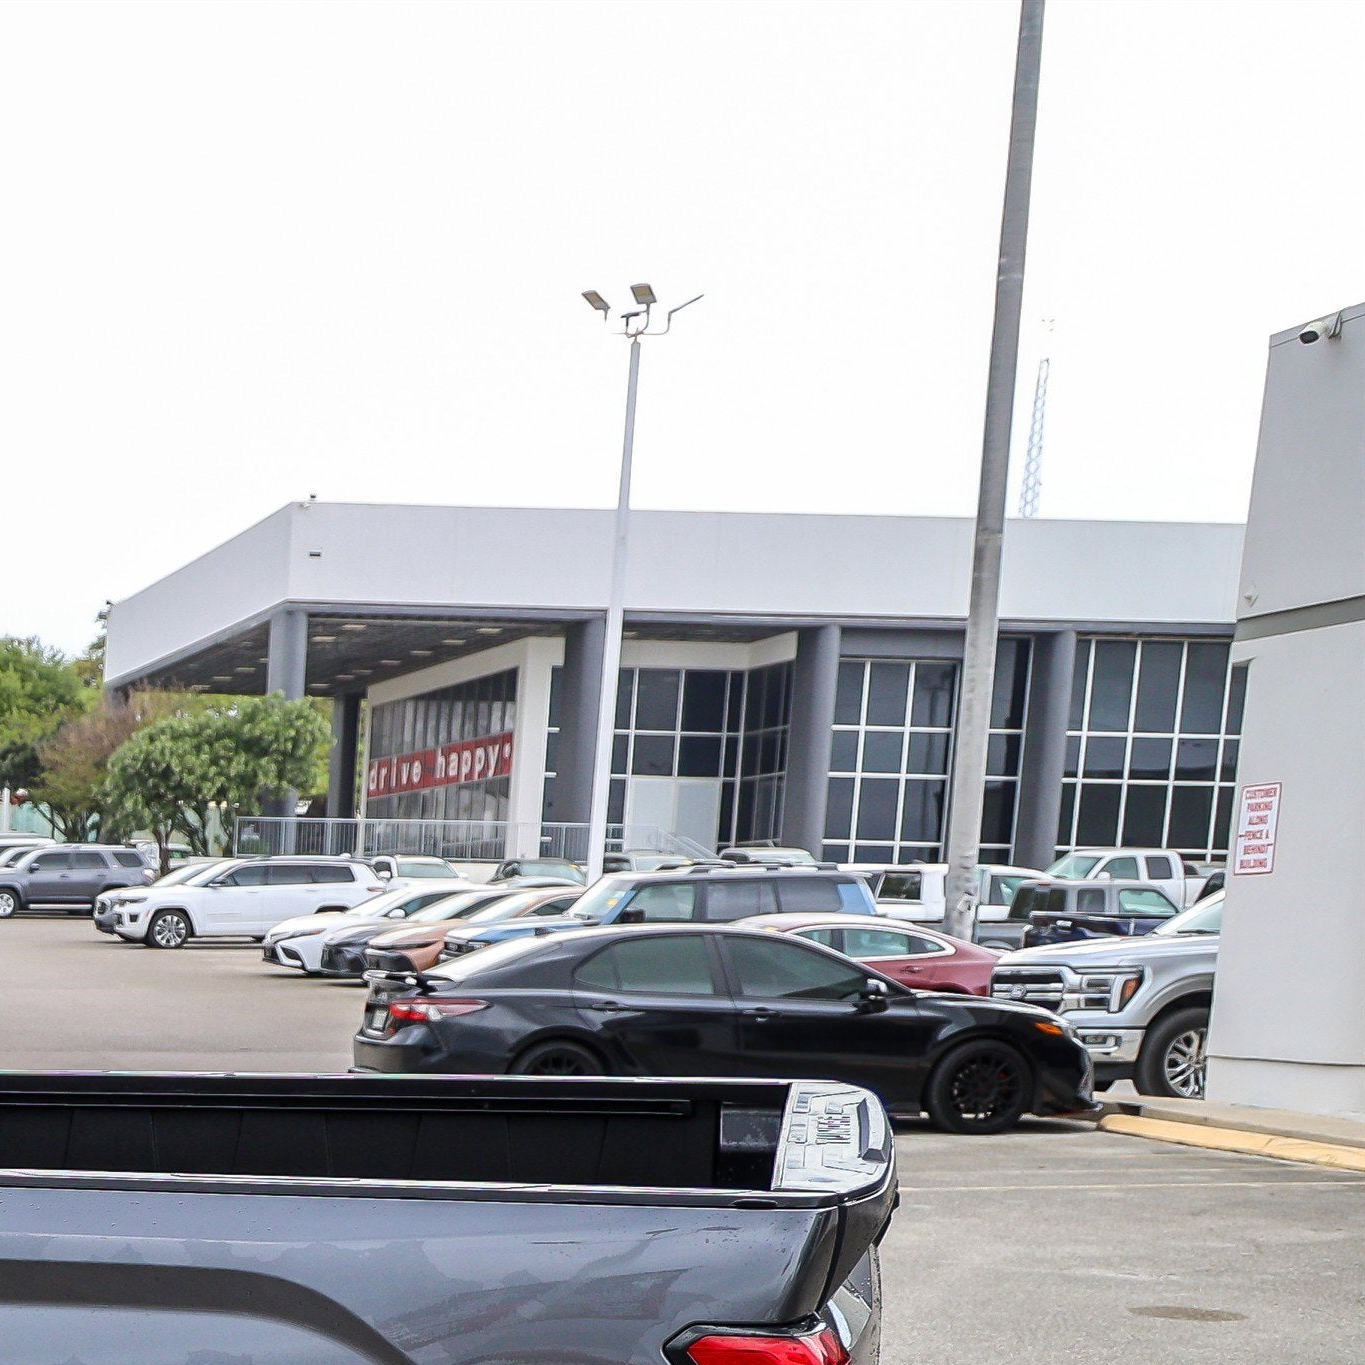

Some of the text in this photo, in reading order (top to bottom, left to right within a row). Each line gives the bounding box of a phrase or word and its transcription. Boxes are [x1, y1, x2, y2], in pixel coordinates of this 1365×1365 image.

[369, 744, 499, 790] drive happy
[1247, 801, 1272, 812] PARKING
[1247, 814, 1268, 826] ALONG
[1243, 844, 1268, 856] BEHIND
[1239, 858, 1267, 869] BUILDING
